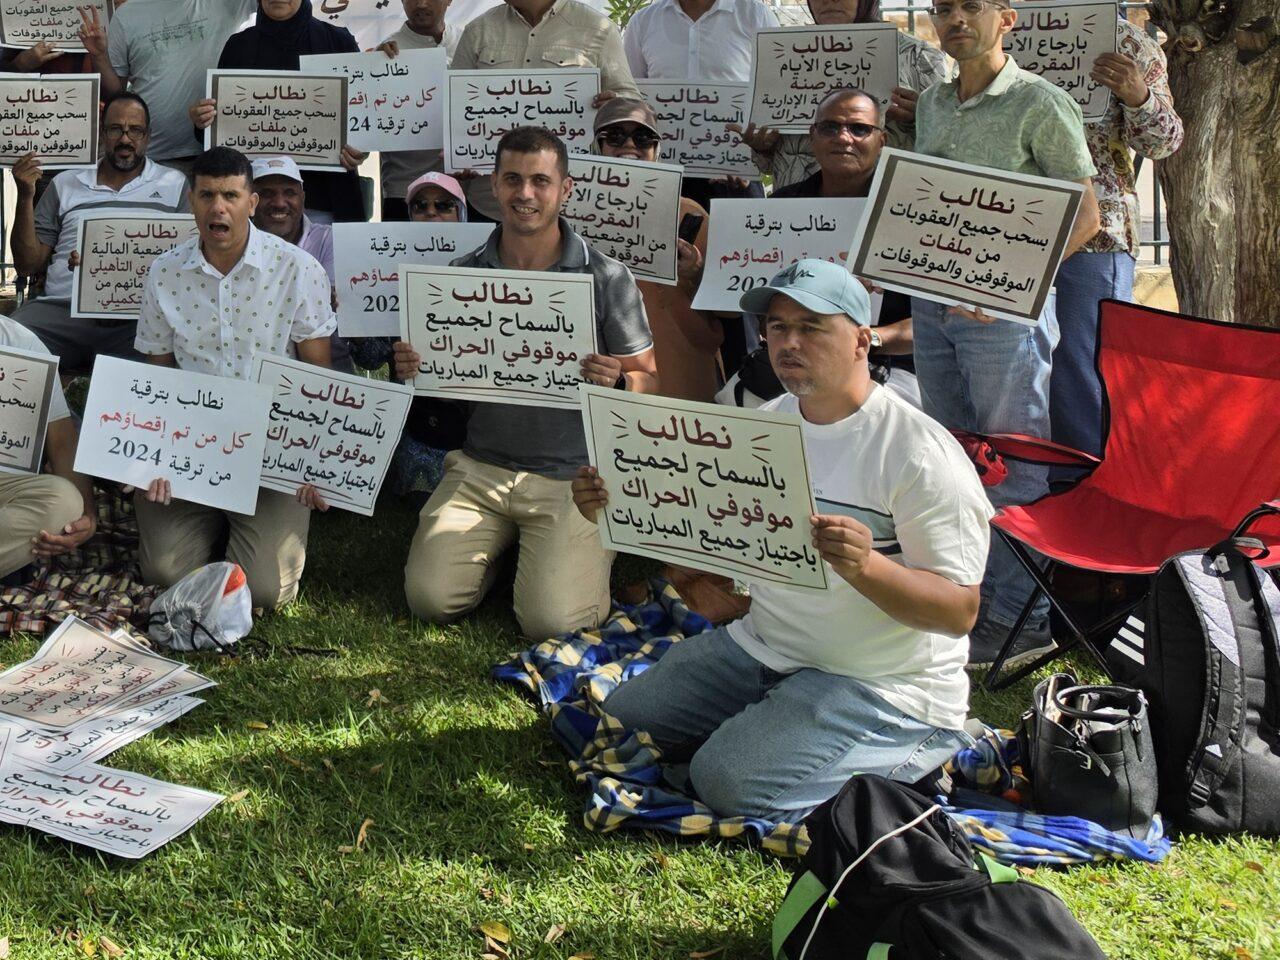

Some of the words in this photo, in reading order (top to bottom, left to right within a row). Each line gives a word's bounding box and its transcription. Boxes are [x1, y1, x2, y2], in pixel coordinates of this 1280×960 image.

[793, 35, 853, 58] نطالب
[780, 58, 818, 76] الايام
[824, 58, 871, 76] بارجاع
[6, 89, 58, 107] نطالب
[253, 86, 306, 103] نطالب
[762, 94, 806, 108] الإدارية
[26, 111, 55, 124] جميع
[56, 111, 87, 122] بسحب
[223, 105, 270, 118] العقوبات
[273, 109, 302, 121] جميع
[304, 110, 336, 120] بسحب
[3, 125, 39, 136] ملفات
[44, 127, 60, 138] من
[249, 122, 287, 133] ملفات
[291, 126, 307, 136] من
[41, 140, 86, 153] الموقوفين
[220, 135, 285, 150] والموقوفات.
[288, 139, 336, 152] الموقوفين
[940, 188, 1015, 214] نطالب
[890, 202, 959, 228] العقوبات
[959, 219, 1001, 241] جميع
[920, 233, 971, 257] ملفات
[1004, 231, 1048, 253] بسحب
[874, 246, 962, 278] والموقوفات.
[975, 248, 1001, 264] من
[965, 268, 1034, 294] الموقوفين
[452, 282, 533, 308] نطالب
[426, 310, 492, 332] لجميع
[499, 312, 574, 339] بالسماح
[430, 334, 494, 358] الحراك
[503, 339, 577, 367] موقوفي
[418, 360, 487, 383] المباريات
[494, 370, 538, 387] جميع
[131, 379, 169, 404] بترقية
[177, 390, 223, 410] نطالب
[301, 382, 365, 409] نطالب
[0, 396, 36, 413] بسحب
[269, 401, 328, 427] لجميع
[100, 410, 166, 439] إقصاؤهم
[172, 427, 190, 445] تم
[328, 414, 385, 444] بالسماح
[637, 415, 732, 449] نطالب
[195, 435, 217, 448] من
[223, 431, 251, 454] كل
[267, 425, 320, 450] الحراك
[108, 437, 162, 465] 2024
[320, 440, 375, 467] موقوفي
[613, 447, 688, 475] لجميع
[170, 455, 204, 480] ترقية
[262, 454, 304, 473] المباري
[304, 465, 336, 484] جميع
[209, 472, 232, 485] من
[337, 471, 376, 495] باجتياز
[696, 457, 786, 499] بالسماح
[622, 477, 697, 509] الحراك
[612, 508, 693, 540] المباريات
[707, 493, 793, 533] موقوفي
[699, 528, 750, 556] جميع
[755, 538, 816, 572] باجتياز
